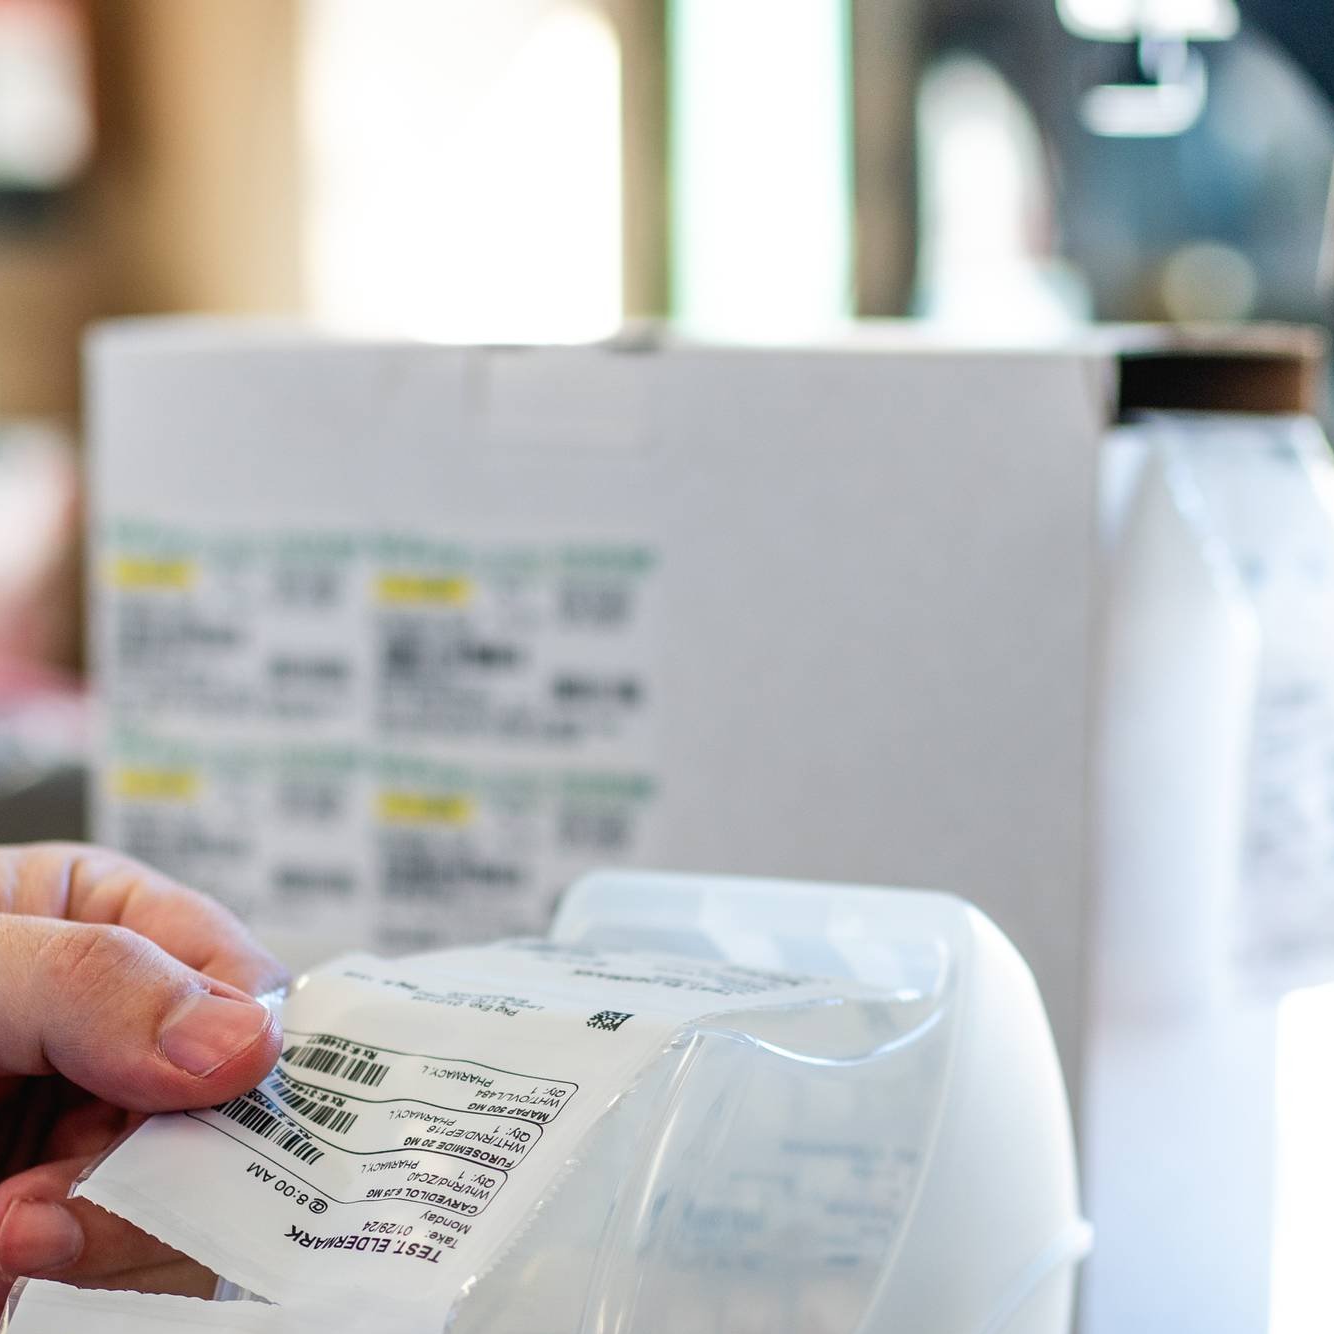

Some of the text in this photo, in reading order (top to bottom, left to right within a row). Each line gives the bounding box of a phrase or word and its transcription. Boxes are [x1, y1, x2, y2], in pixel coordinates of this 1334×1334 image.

[363, 1050, 378, 1060] Rx
[420, 1065, 429, 1074] L
[475, 1088, 560, 1108] WHT/OVL/L484
[531, 1086, 537, 1094] 1
[544, 1087, 567, 1098] Qty:
[331, 1096, 345, 1108] Rx
[467, 1102, 549, 1122] MAPAP 500 MG
[493, 1124, 500, 1134] 1
[505, 1126, 531, 1142] Qty:
[427, 1125, 526, 1154] WHT/RND/EP116
[403, 1136, 515, 1168] FUROSEMIDE 20 MG
[246, 1162, 276, 1182] AM
[458, 1170, 465, 1180] 1
[471, 1174, 495, 1188] Qty:
[366, 1188, 383, 1198] MG
[407, 1172, 489, 1200] Wht/Rnd/ZC40
[405, 1188, 478, 1214] CARVEDILOL
[419, 1210, 472, 1234] Monday
[362, 1220, 459, 1249] Take: 01/29/24
[284, 1225, 443, 1263] TEST. ELDERMARK
